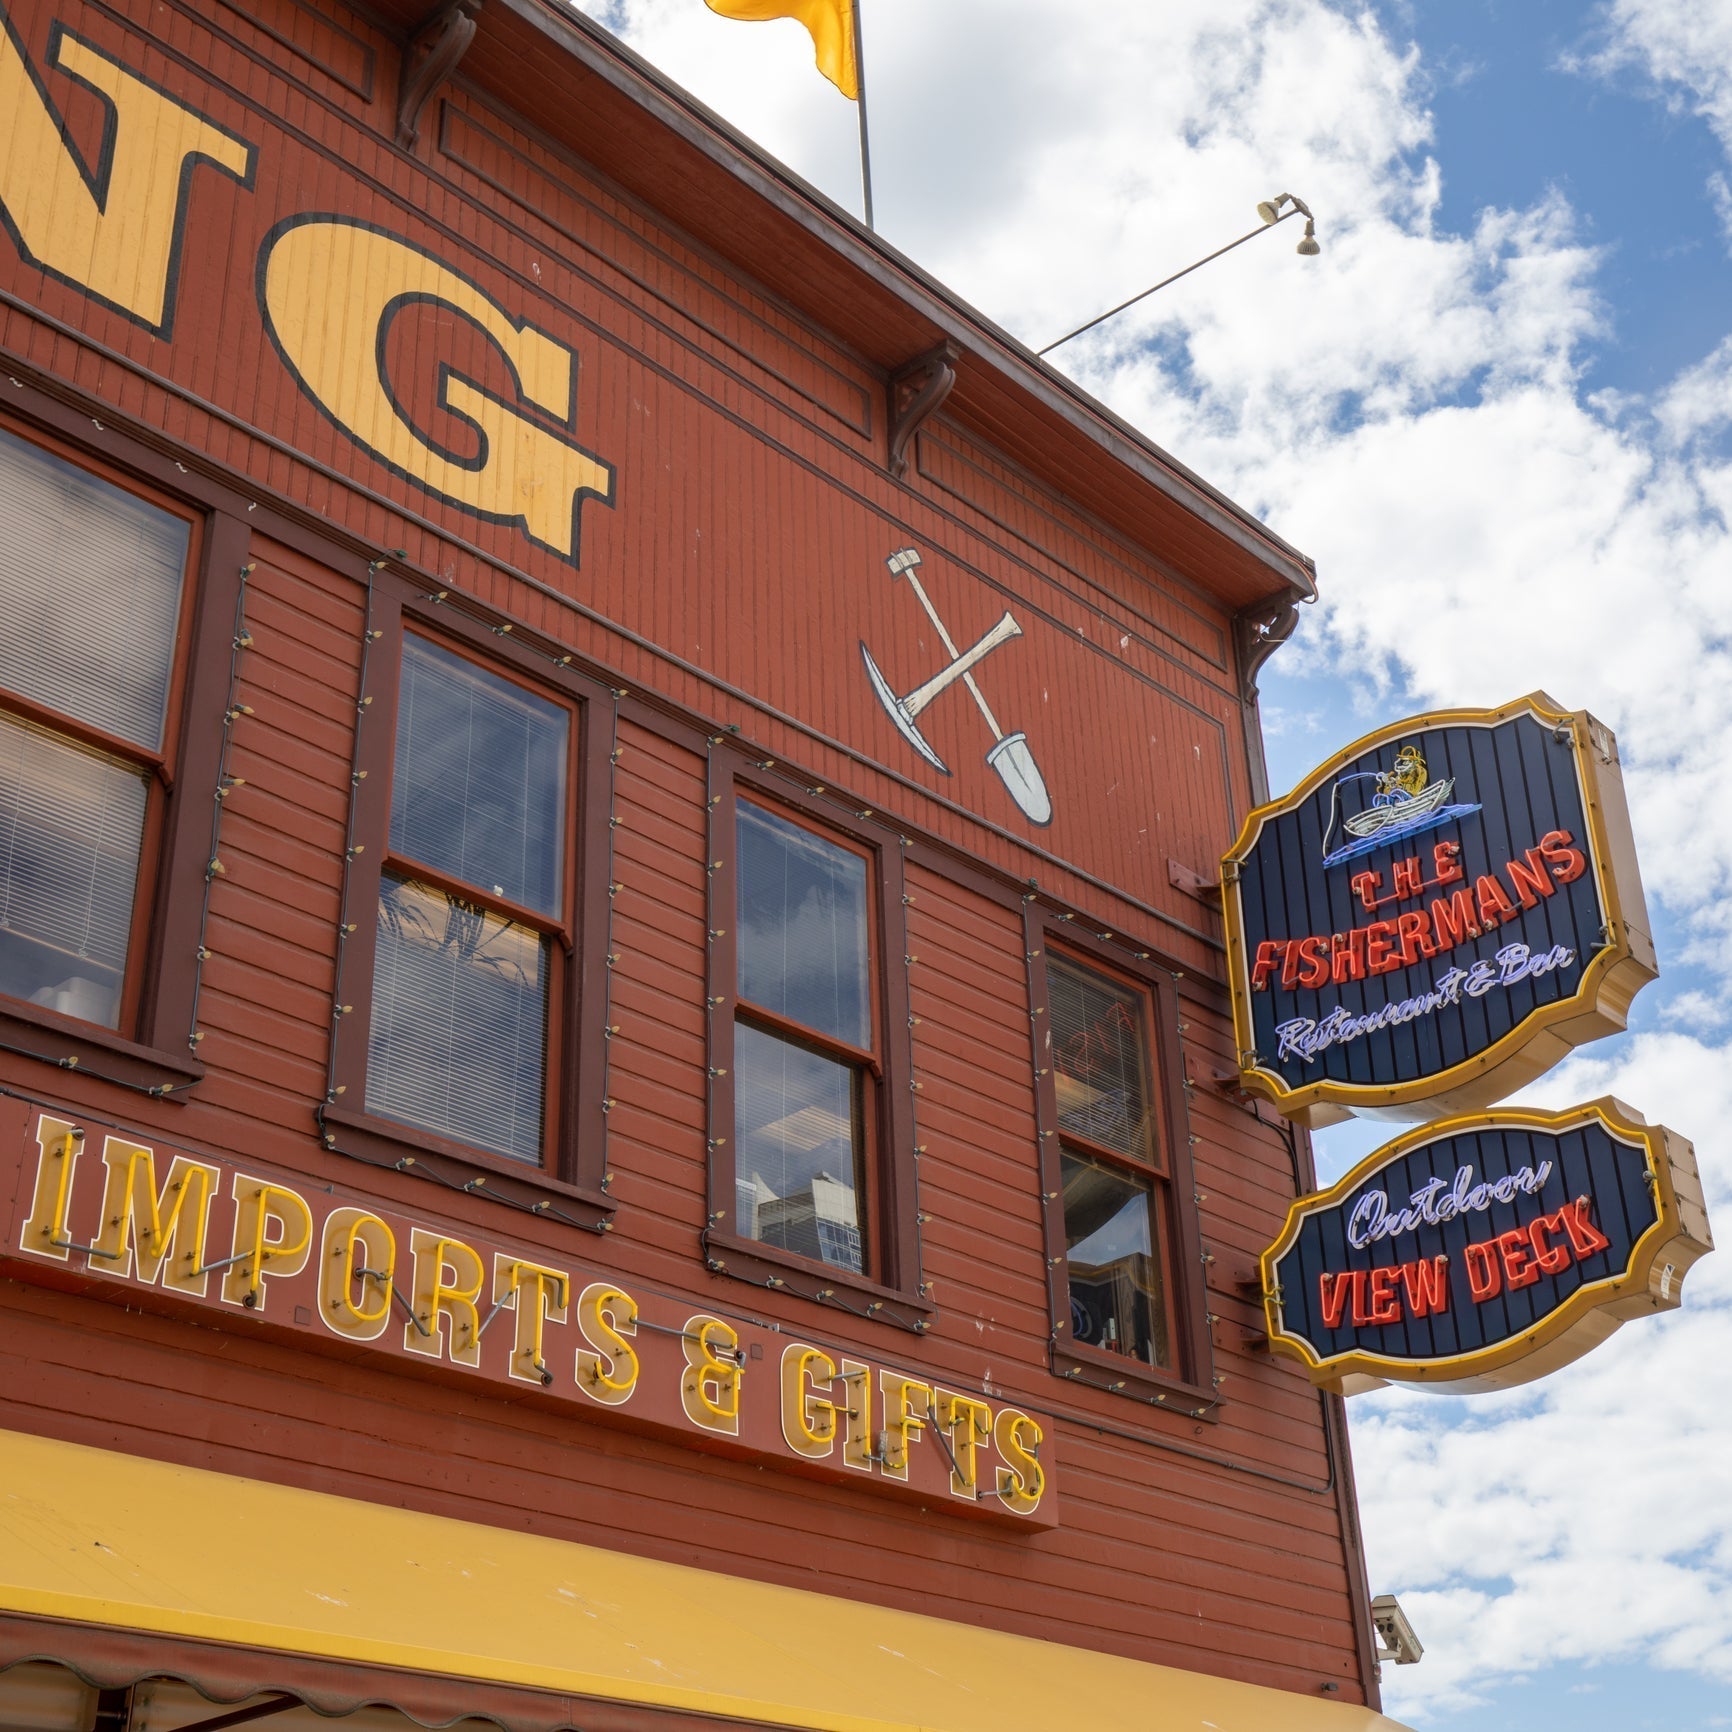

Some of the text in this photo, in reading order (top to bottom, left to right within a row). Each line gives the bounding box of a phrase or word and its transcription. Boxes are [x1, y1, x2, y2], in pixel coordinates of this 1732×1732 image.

[1252, 830, 1586, 991] FISHERMANS
[1351, 841, 1464, 912] THE
[1275, 942, 1576, 1063] Restaurant & Bar
[1319, 1194, 1609, 1329] VIEW DECK
[1347, 1160, 1552, 1249] Outdoor
[19, 1114, 1045, 1515] IMPORTS & GIFTS
